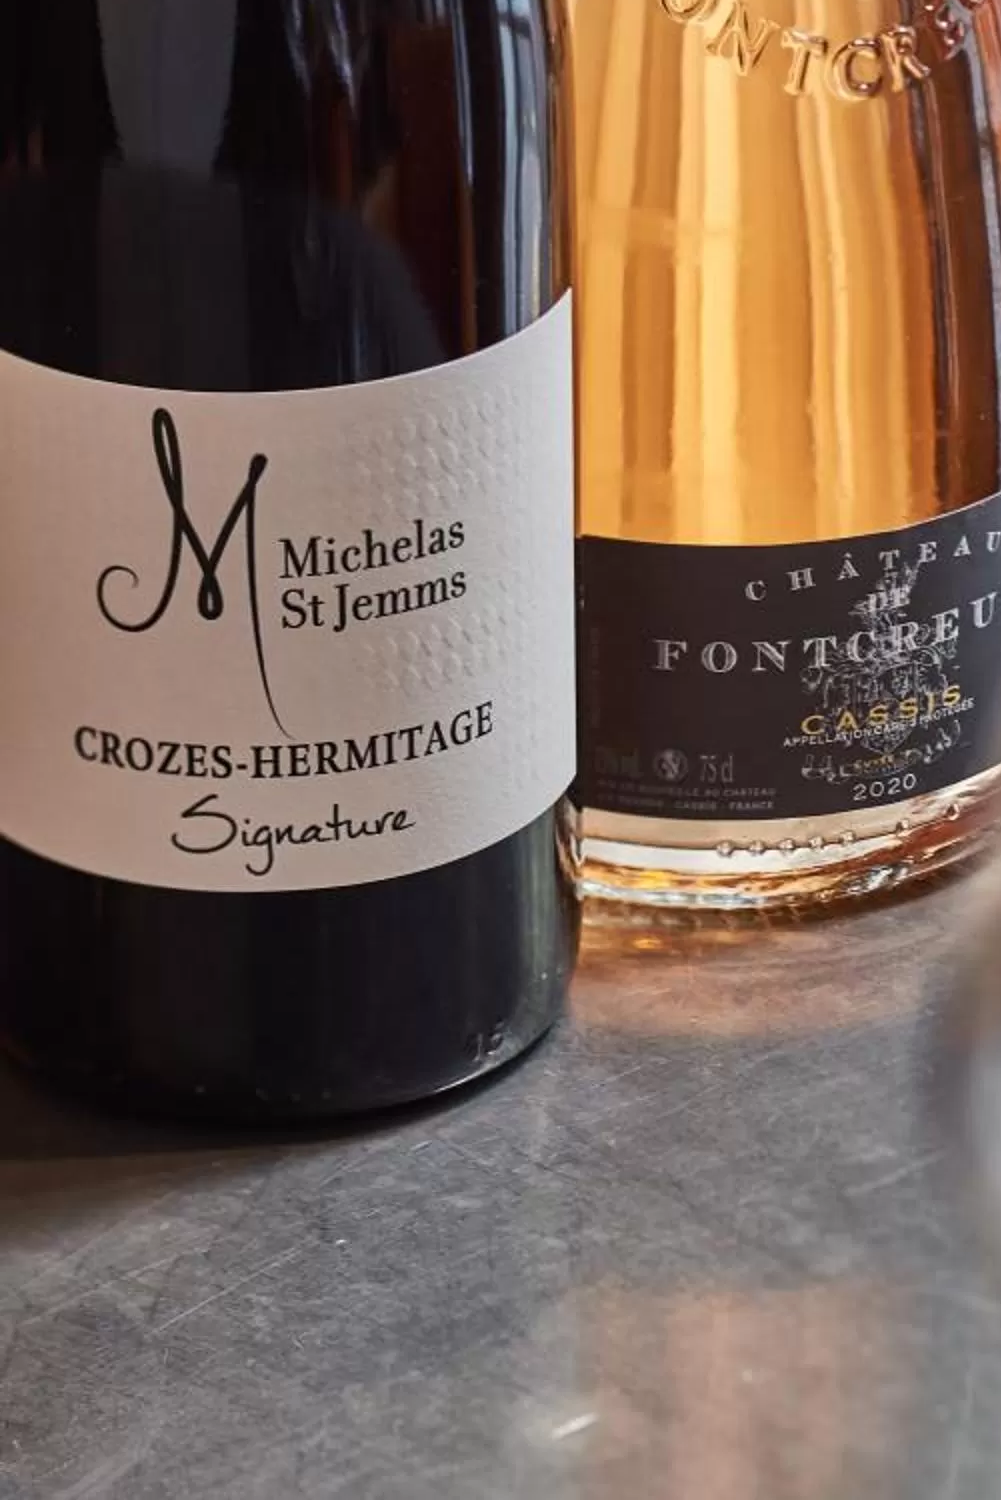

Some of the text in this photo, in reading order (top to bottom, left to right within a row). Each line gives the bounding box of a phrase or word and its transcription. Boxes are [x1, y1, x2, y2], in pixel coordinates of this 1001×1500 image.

[278, 518, 466, 580] Michelas
[281, 570, 468, 633] St Jemms
[73, 700, 496, 780] CROZES-HERMITAGE
[800, 684, 962, 736] CASSIS
[852, 772, 918, 801] 2020
[171, 792, 417, 877] Signature
